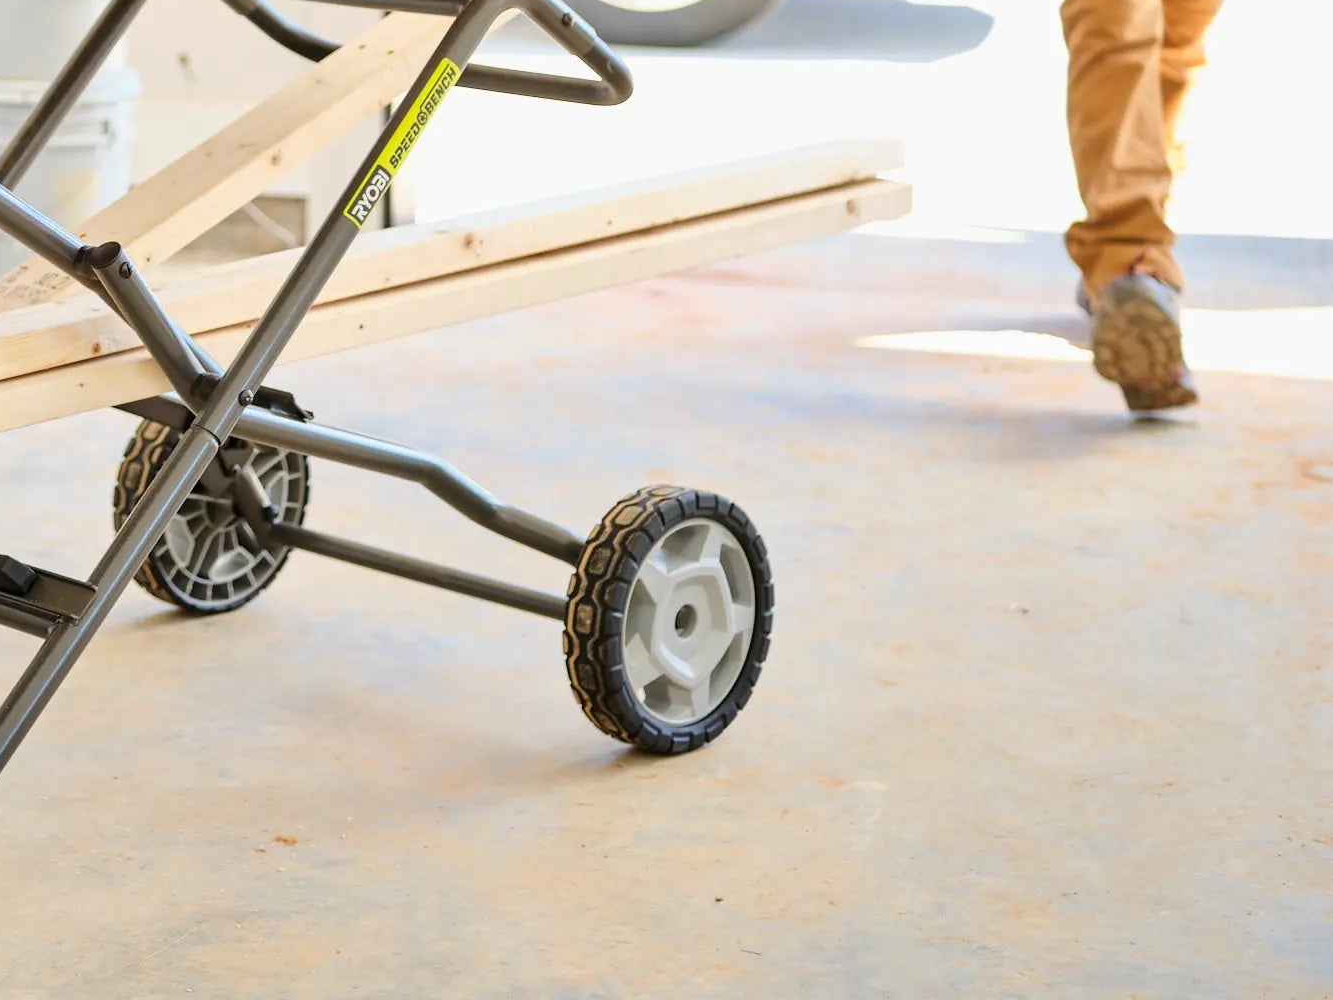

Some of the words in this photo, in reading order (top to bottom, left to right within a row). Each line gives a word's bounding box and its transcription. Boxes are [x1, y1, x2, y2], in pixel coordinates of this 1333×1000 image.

[351, 168, 390, 222] RYOBI
[389, 122, 421, 169] SPEED
[426, 66, 457, 116] BENCH
